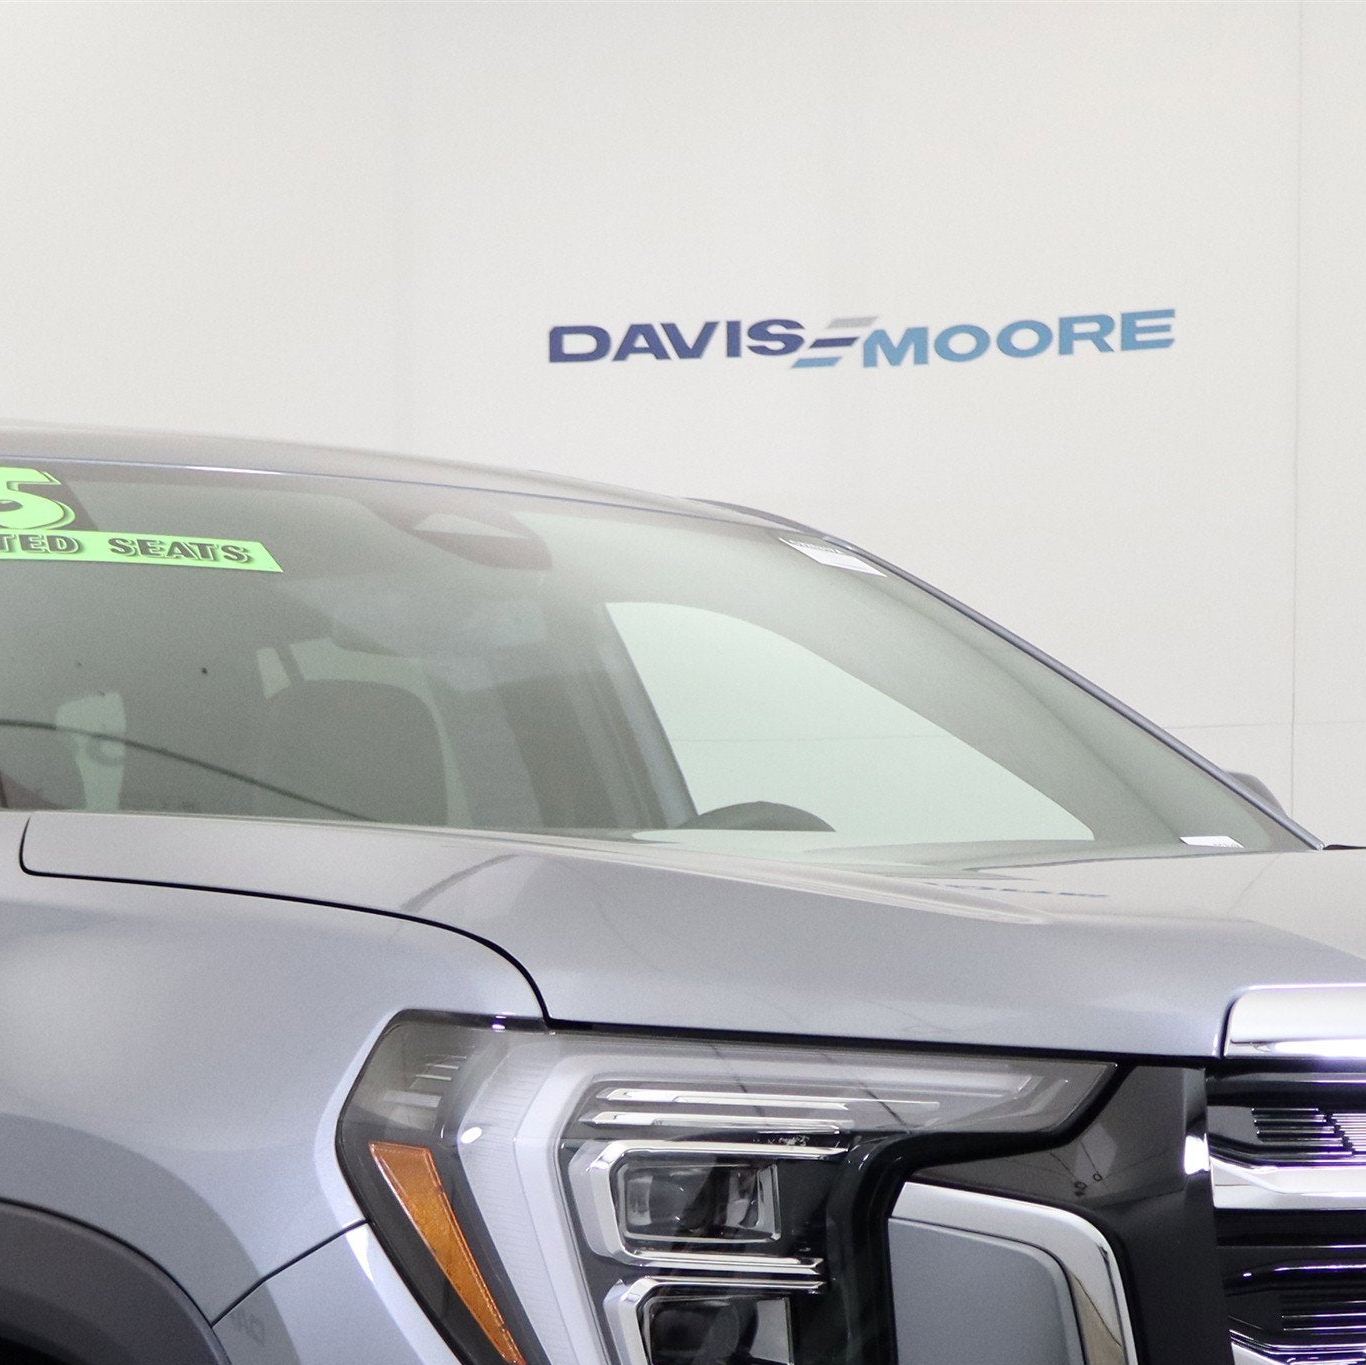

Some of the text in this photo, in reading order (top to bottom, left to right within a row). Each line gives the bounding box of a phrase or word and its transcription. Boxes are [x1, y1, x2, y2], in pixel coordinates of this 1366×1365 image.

[547, 308, 1177, 369] DAVIS MOORE
[107, 535, 252, 565] SEATS
